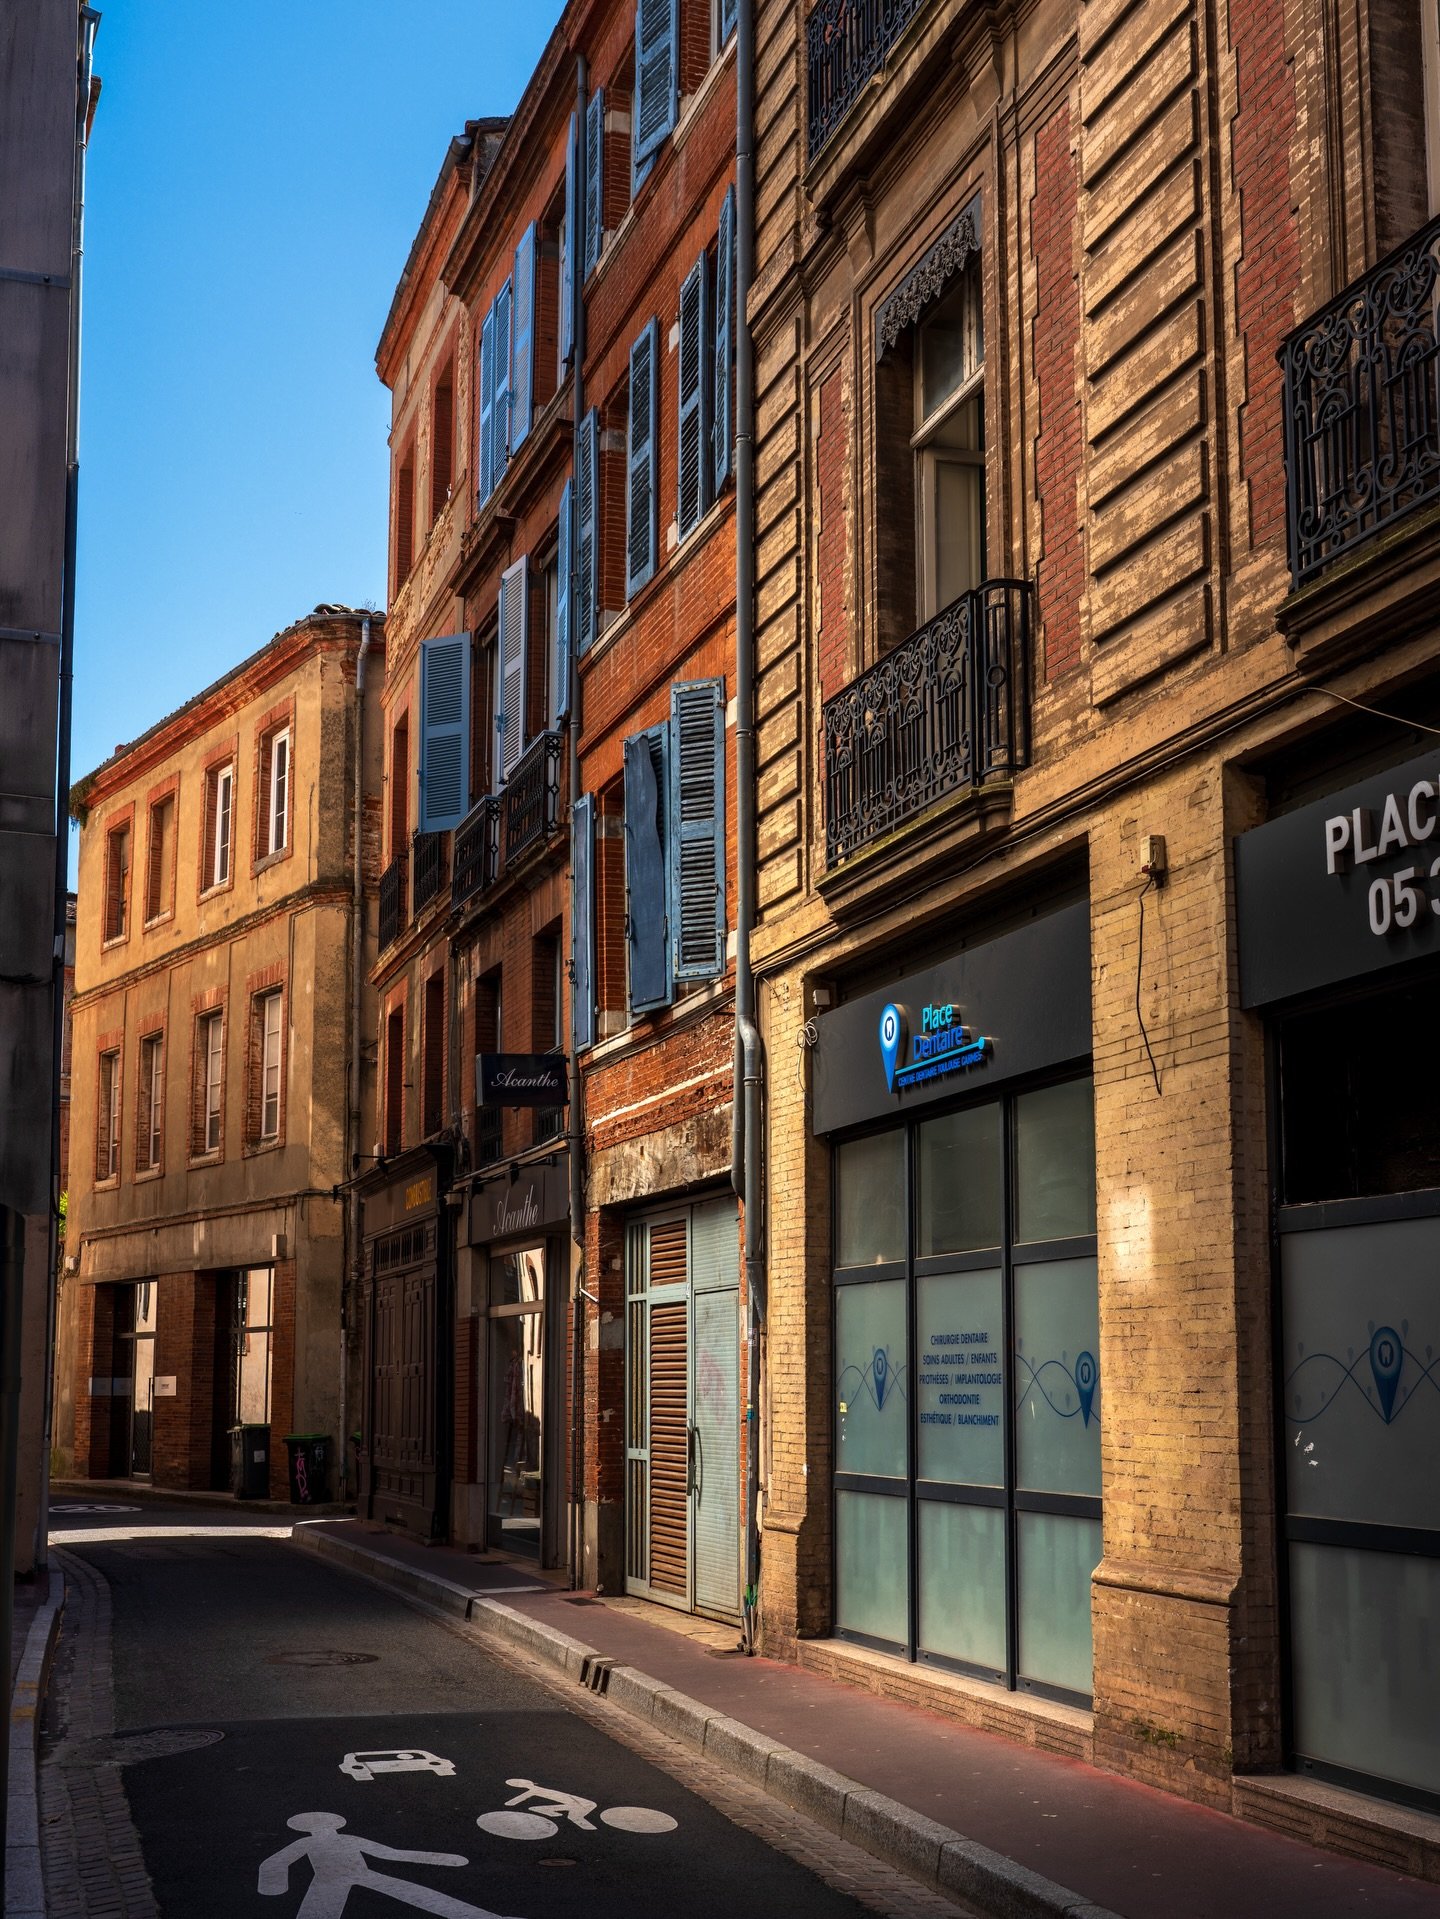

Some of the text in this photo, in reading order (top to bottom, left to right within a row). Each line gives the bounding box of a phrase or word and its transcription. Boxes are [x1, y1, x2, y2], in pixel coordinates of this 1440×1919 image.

[1326, 774, 1440, 874] PLAC
[1368, 866, 1418, 936] 05
[922, 1003, 953, 1033] Place
[913, 1025, 963, 1060] Dentaire
[490, 1068, 559, 1087] Acanthe
[493, 1184, 539, 1236] Acanthe
[931, 1332, 988, 1345] CHIRURGIE DENTAIRE
[923, 1354, 940, 1365] SOINS
[941, 1353, 965, 1365] ADULTES
[971, 1352, 998, 1364] ENFANTS
[955, 1373, 1002, 1385] IMPLANTOLOGIE
[939, 1394, 980, 1405] ORTHODONTIE
